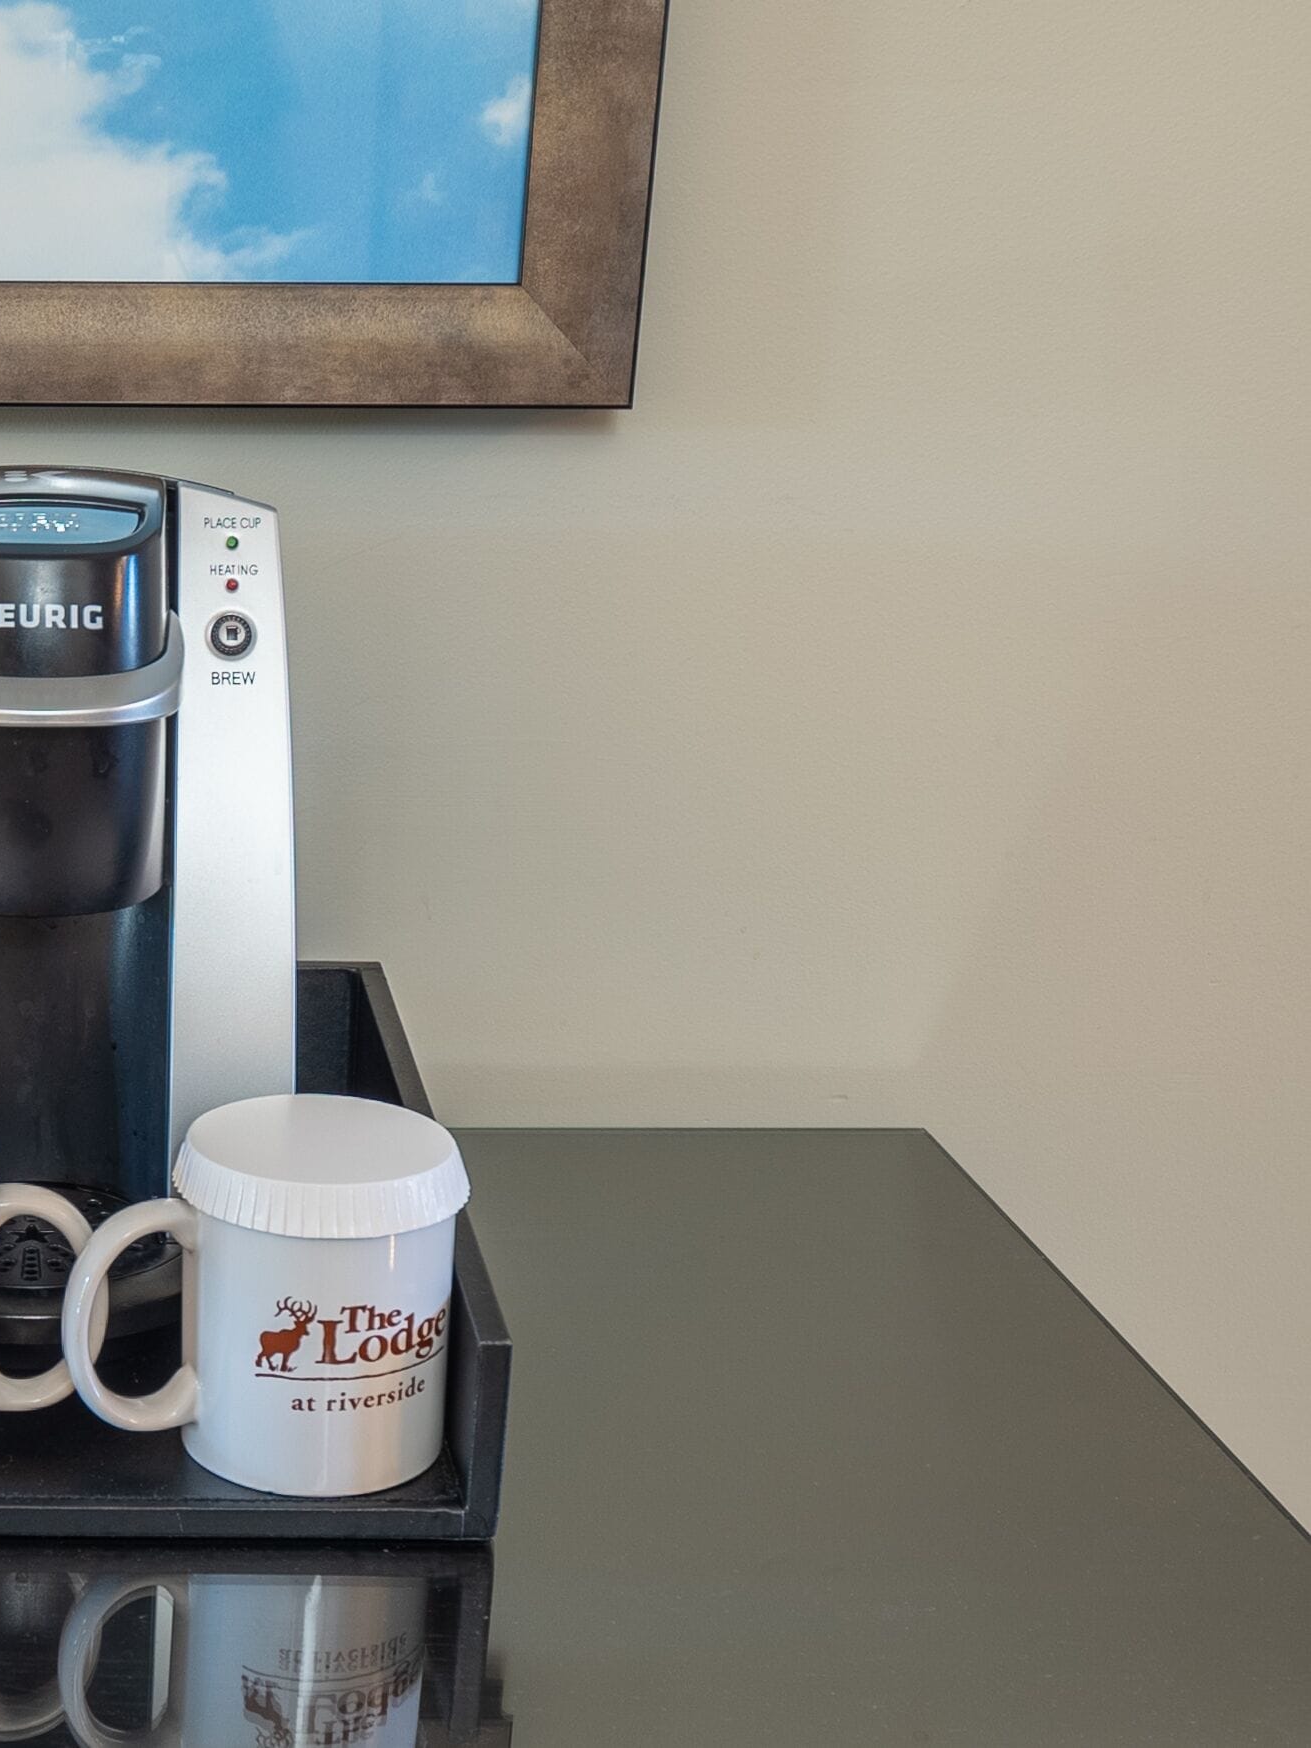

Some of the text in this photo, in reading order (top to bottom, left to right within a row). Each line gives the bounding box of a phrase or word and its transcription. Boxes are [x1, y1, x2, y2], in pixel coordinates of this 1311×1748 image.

[203, 517, 262, 529] PLACE CUP
[209, 564, 259, 576] HEATING
[210, 671, 256, 686] BREW
[339, 1304, 402, 1335] The
[314, 1307, 447, 1359] Lodge
[291, 1375, 426, 1412] at riverside
